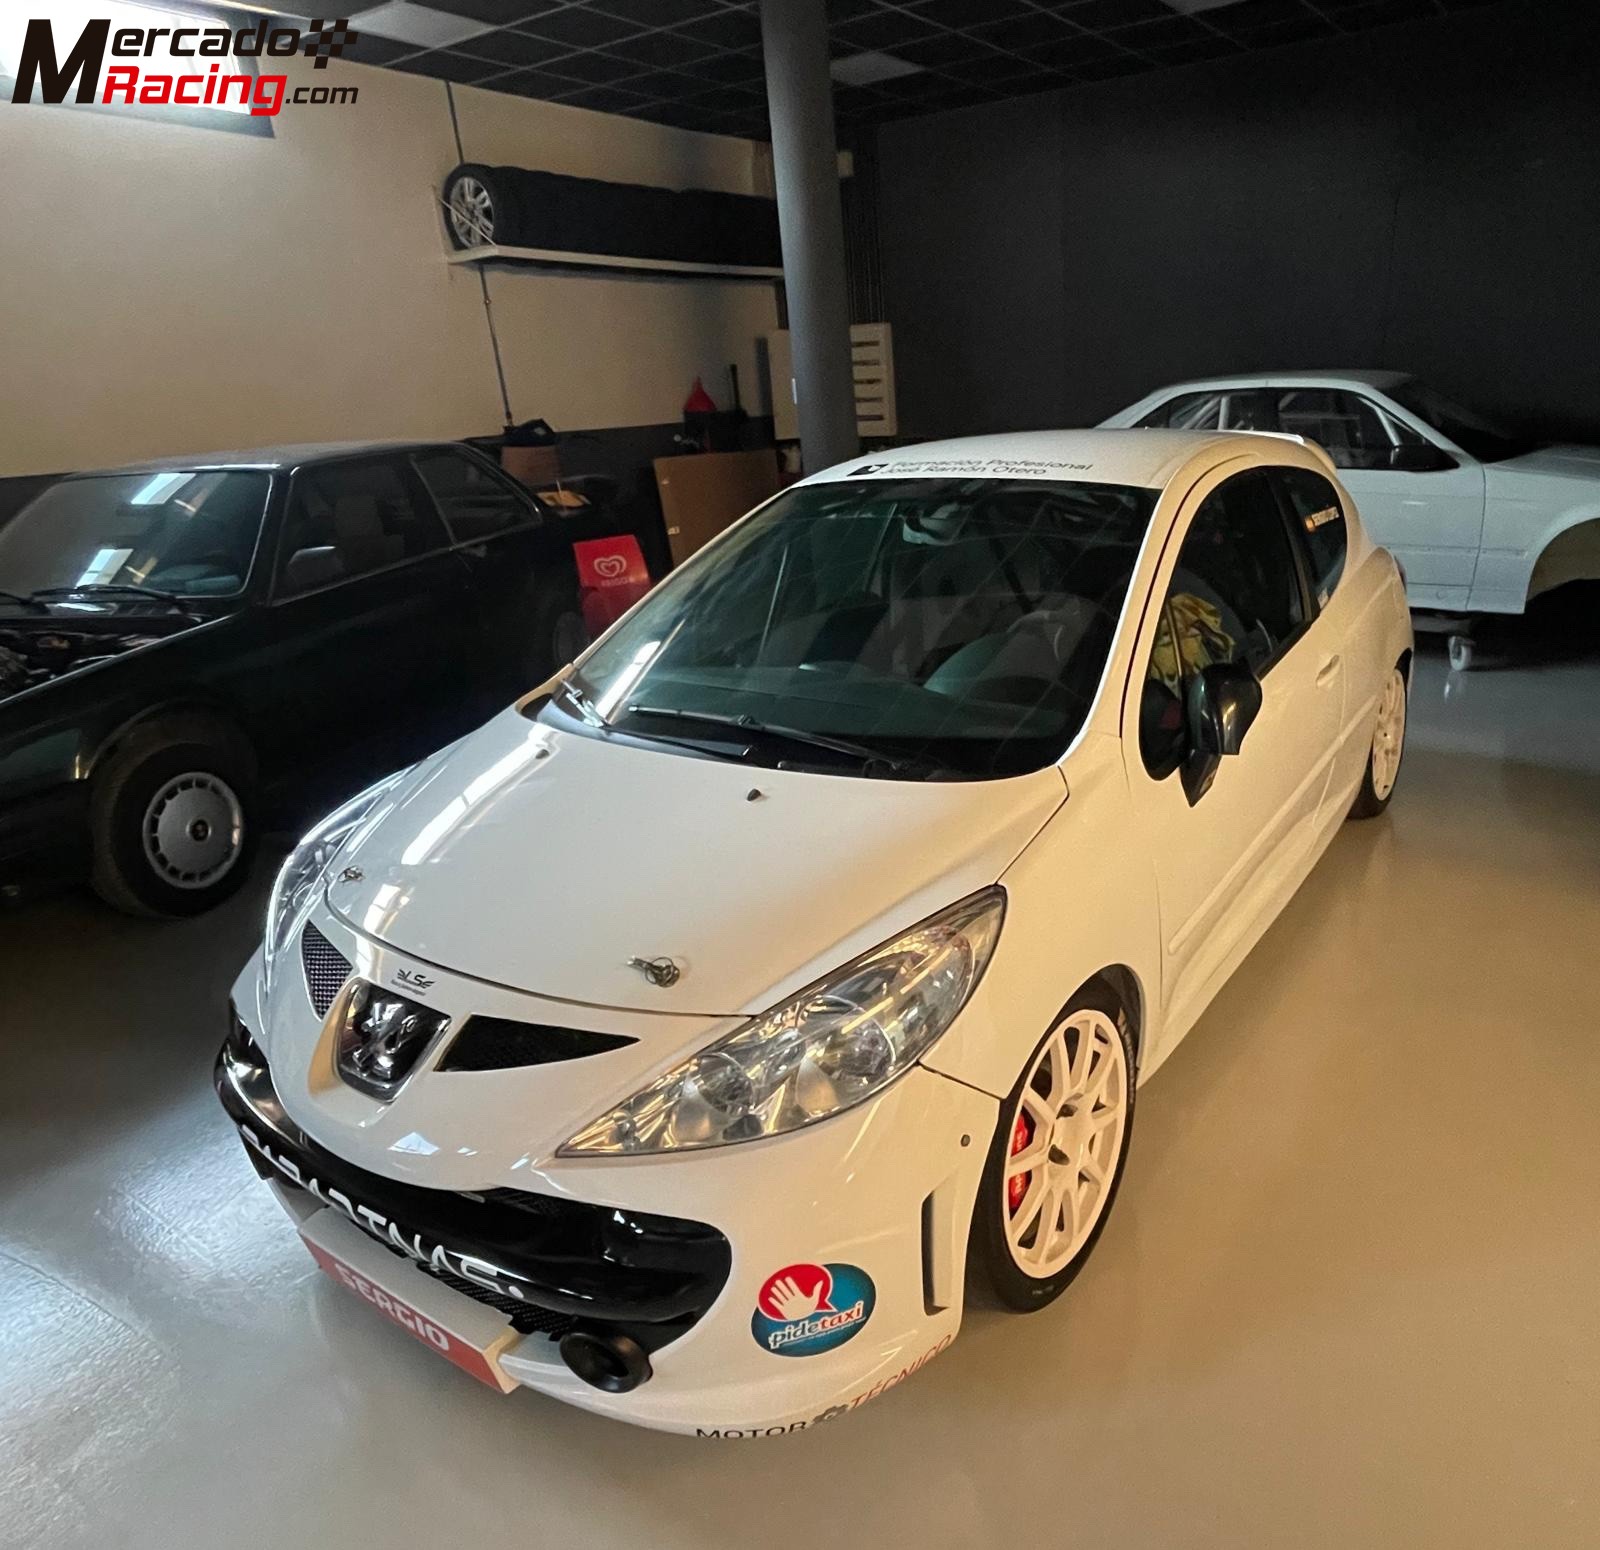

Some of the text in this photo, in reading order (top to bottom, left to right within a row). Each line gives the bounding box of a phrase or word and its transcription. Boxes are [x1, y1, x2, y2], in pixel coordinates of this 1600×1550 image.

[921, 465, 986, 473] Ramón
[992, 466, 1046, 475] Otero
[986, 459, 1093, 470] Profesional
[335, 1262, 450, 1351] SERGIO
[768, 1299, 865, 1350] pidetaxi
[696, 1421, 807, 1439] MOTOR
